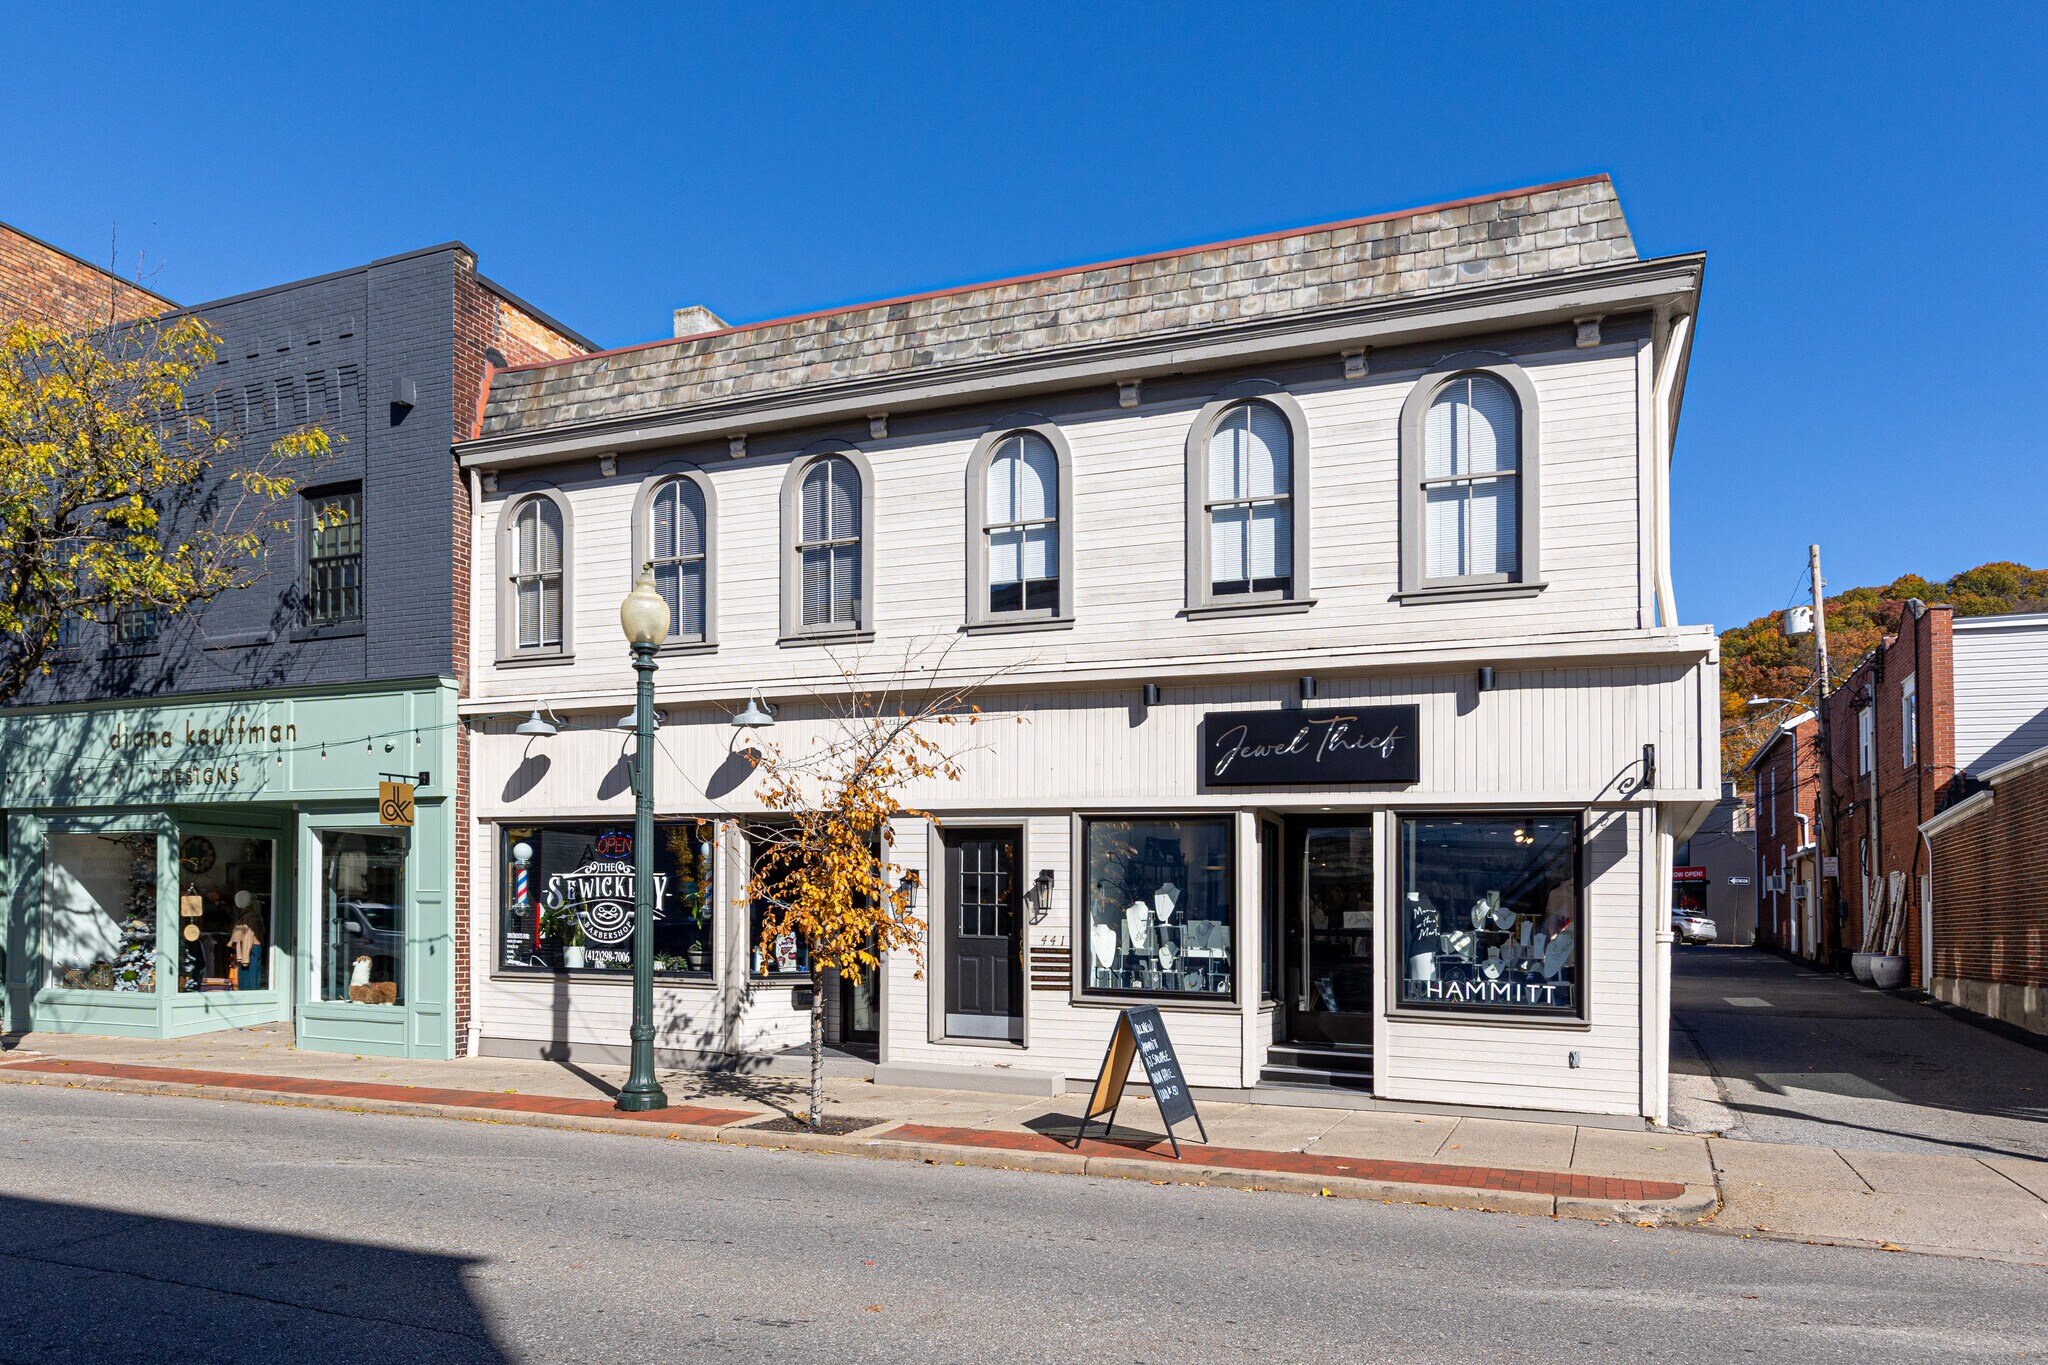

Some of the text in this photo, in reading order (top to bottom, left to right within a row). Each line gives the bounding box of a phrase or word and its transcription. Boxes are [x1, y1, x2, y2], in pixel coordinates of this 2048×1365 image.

[110, 716, 297, 749] diana kauffman
[1214, 715, 1405, 776] Jewel Thief
[161, 767, 239, 786] DESIGNS
[597, 837, 633, 854] OPEN
[599, 862, 616, 872] THE
[546, 876, 668, 911] SEWICKLY
[584, 921, 633, 940] BARBERSHOP
[1040, 934, 1065, 946] 441
[584, 949, 631, 963] (412)298-7006
[1426, 980, 1557, 1004] HAMMITT
